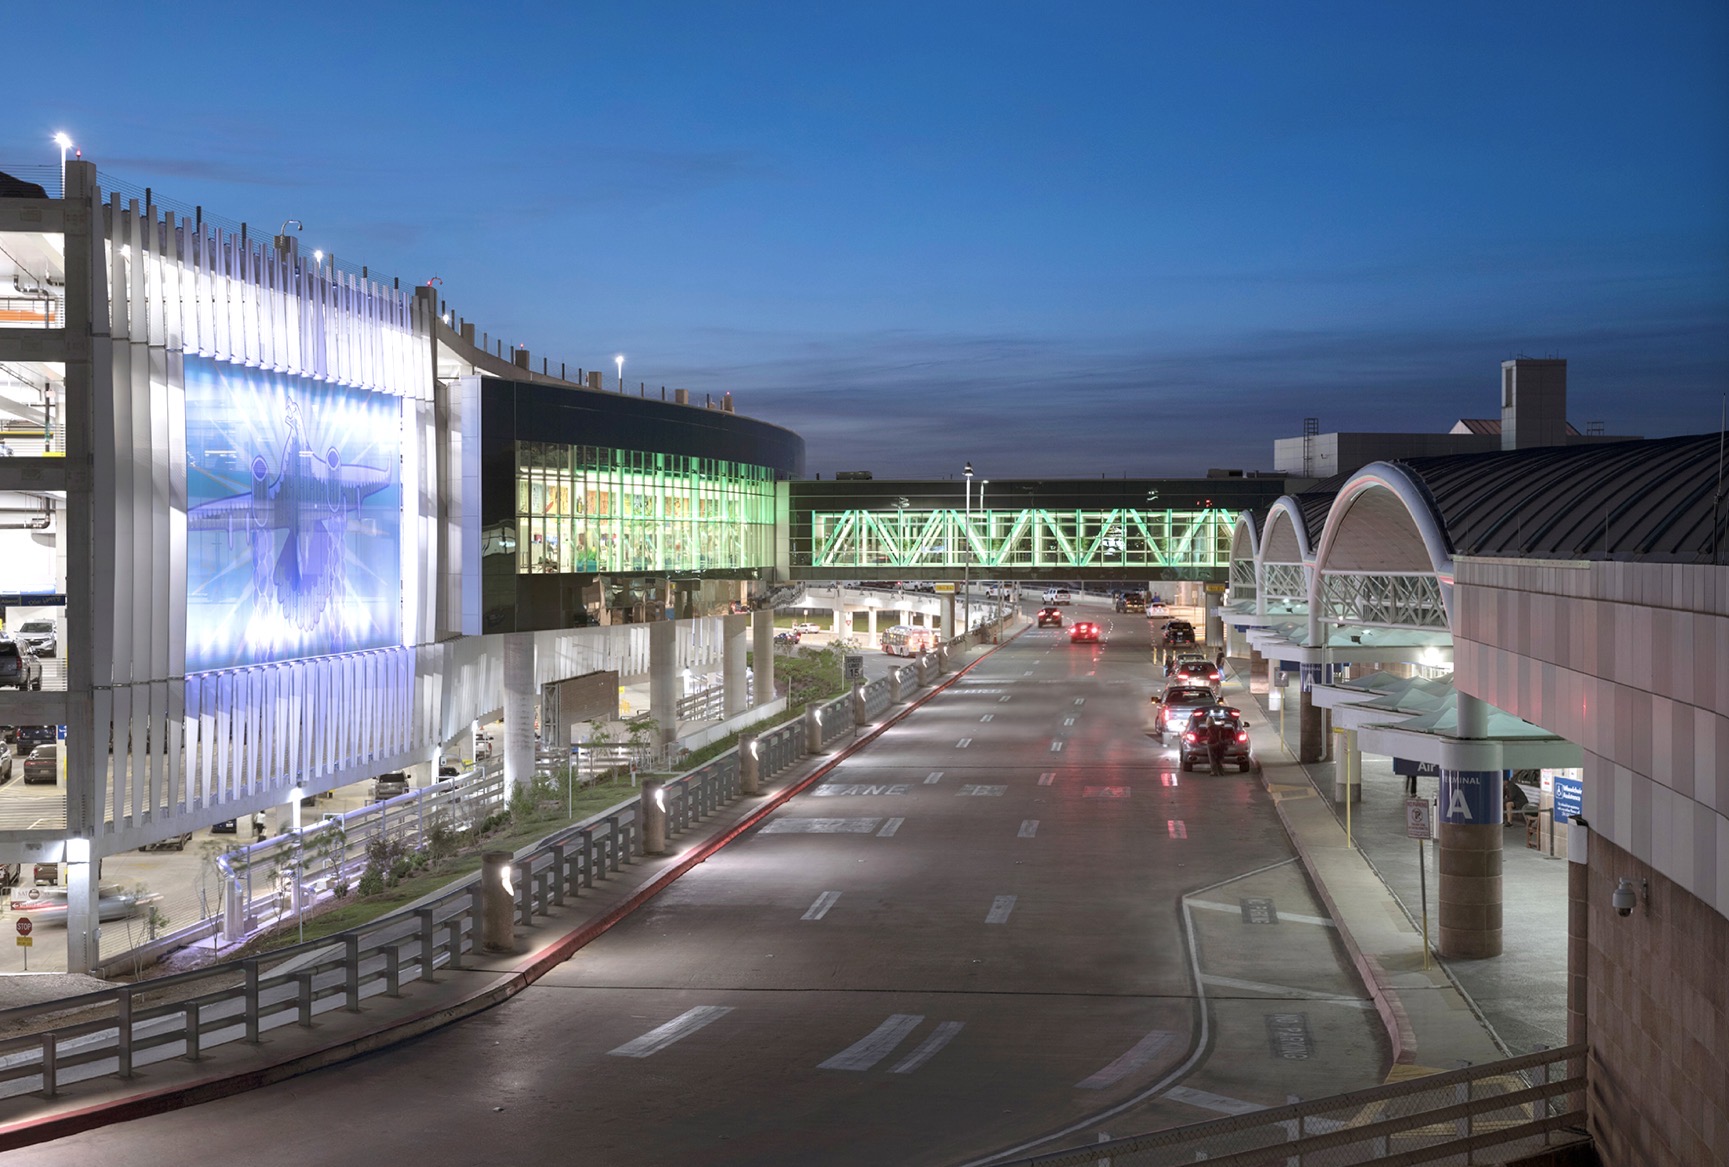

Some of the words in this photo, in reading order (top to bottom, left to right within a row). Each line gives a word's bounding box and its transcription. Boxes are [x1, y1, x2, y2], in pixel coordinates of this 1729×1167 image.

[850, 668, 859, 676] 15
[1304, 673, 1316, 689] A
[1418, 762, 1436, 772] Air
[816, 784, 907, 796] ANE
[1446, 789, 1473, 819] A
[1279, 1027, 1308, 1060] PARKING
